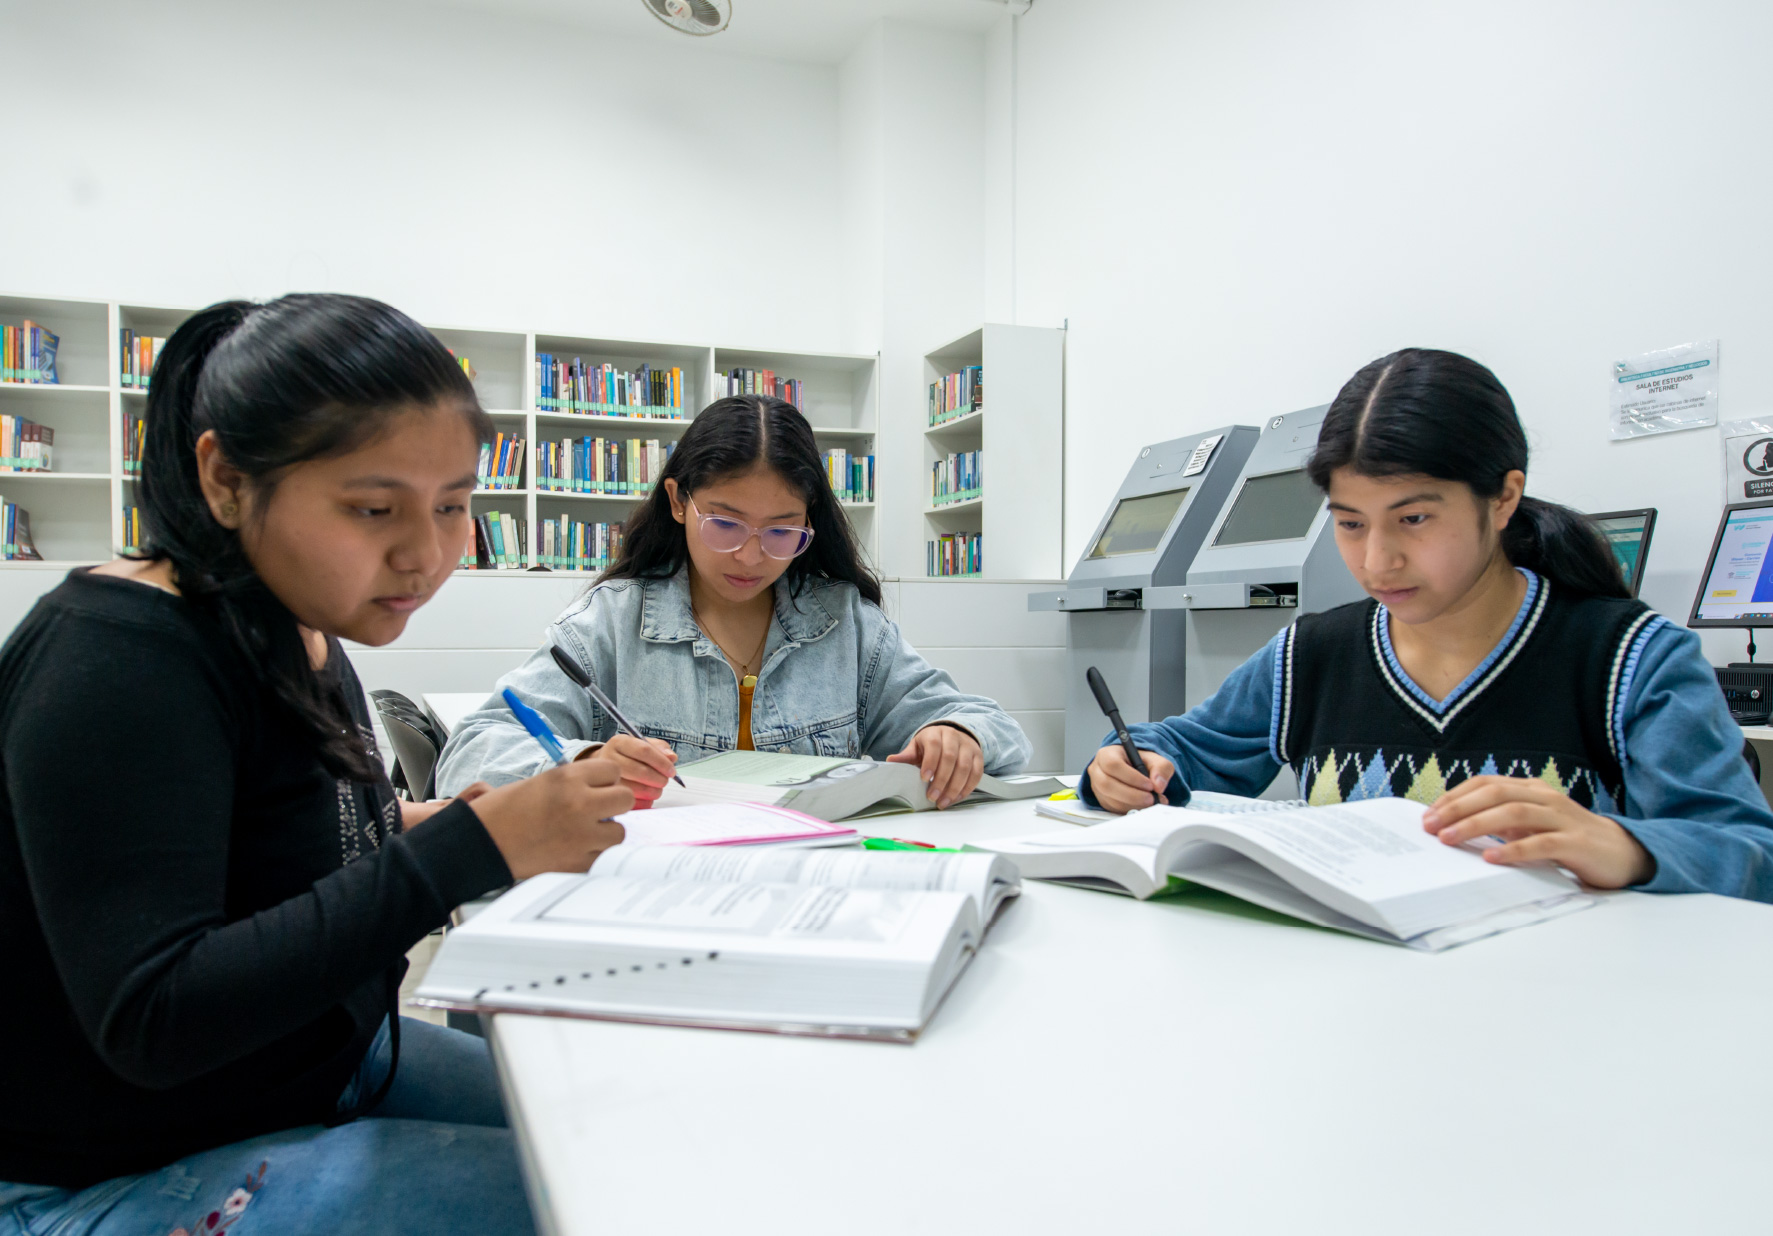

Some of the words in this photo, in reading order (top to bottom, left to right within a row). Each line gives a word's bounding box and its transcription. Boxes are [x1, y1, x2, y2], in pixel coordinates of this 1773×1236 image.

[1636, 382, 1651, 390] SALA
[1662, 374, 1693, 385] ESTUDIOS
[1649, 383, 1679, 394] INTERNET
